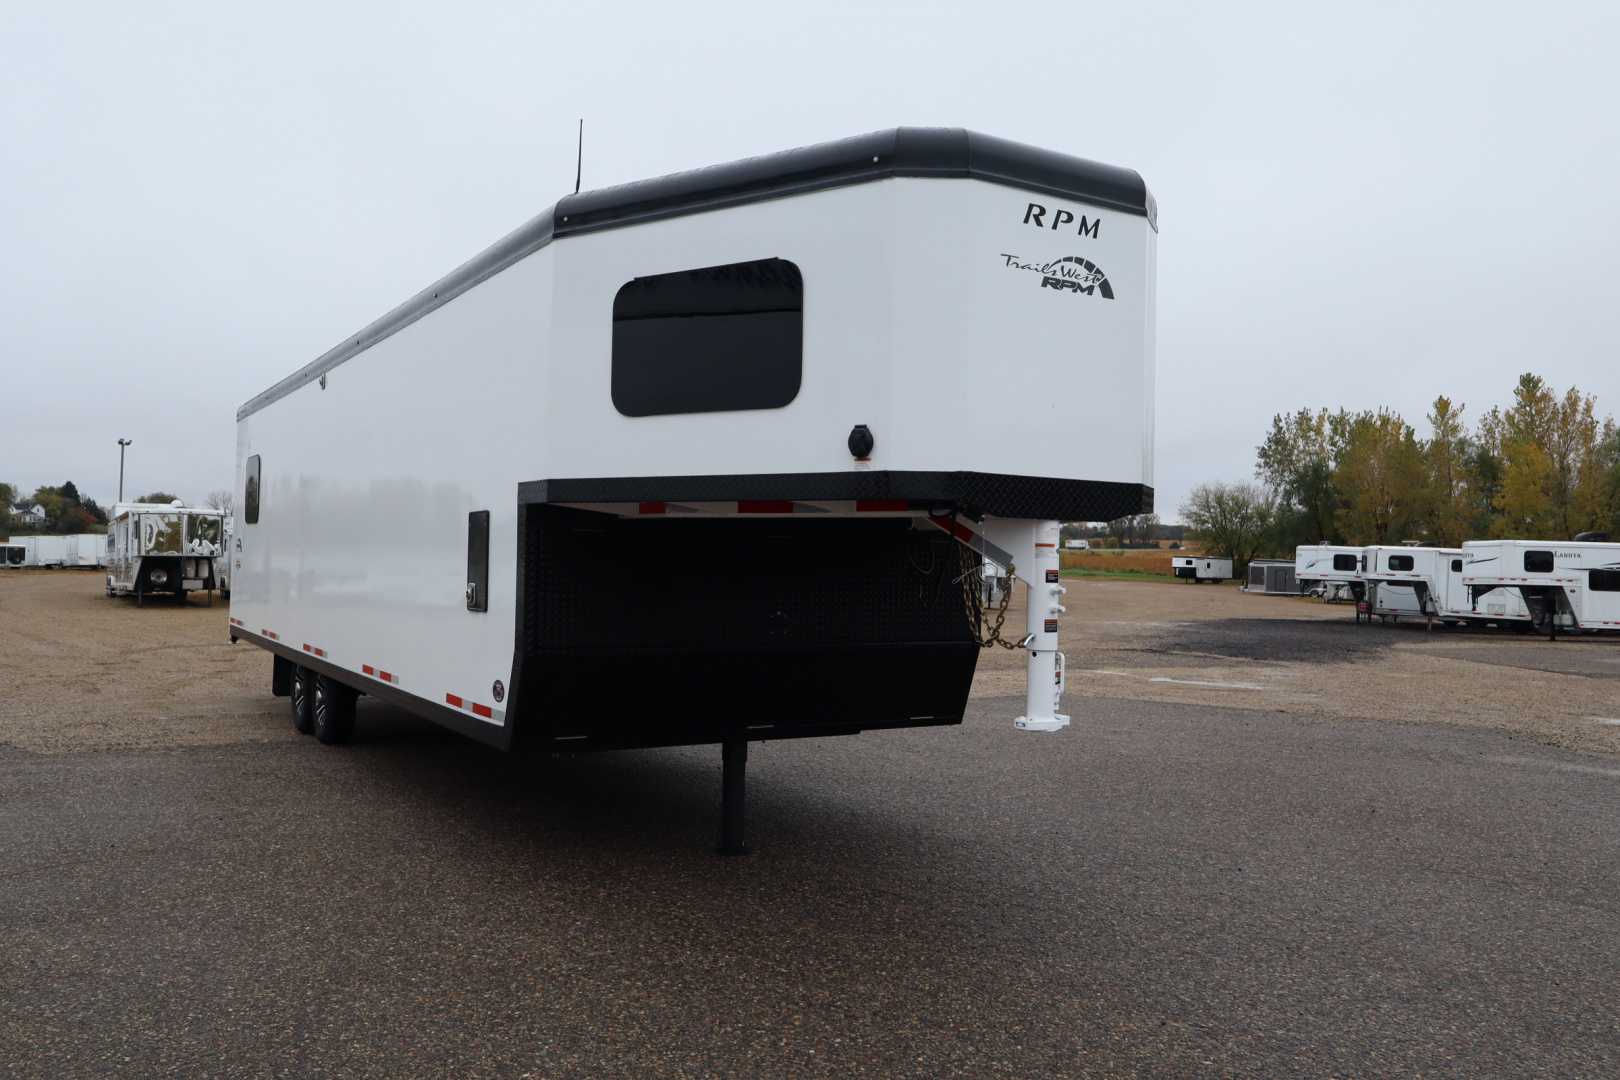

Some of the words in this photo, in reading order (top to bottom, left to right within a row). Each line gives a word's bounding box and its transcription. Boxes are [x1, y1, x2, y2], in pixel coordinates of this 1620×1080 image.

[1023, 202, 1101, 239] RPM
[1000, 253, 1058, 276] Trails
[1060, 265, 1100, 284] West
[1041, 276, 1095, 296] RPM
